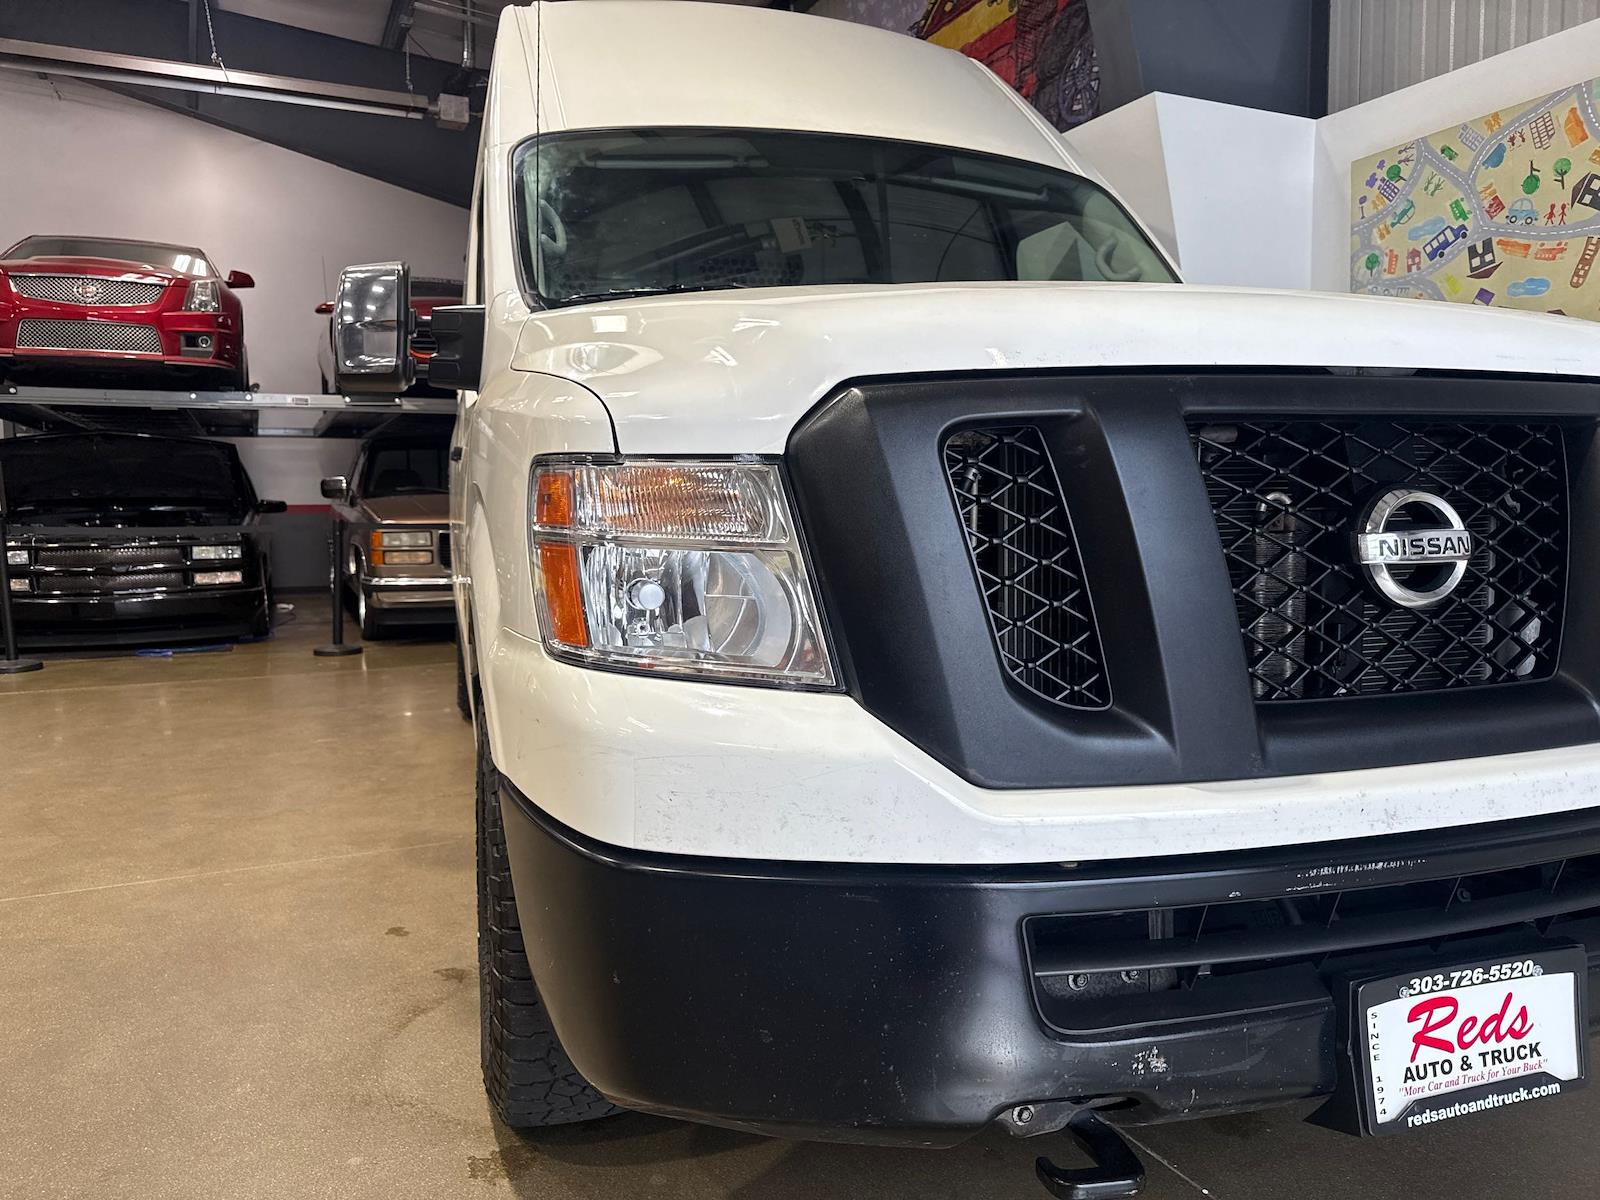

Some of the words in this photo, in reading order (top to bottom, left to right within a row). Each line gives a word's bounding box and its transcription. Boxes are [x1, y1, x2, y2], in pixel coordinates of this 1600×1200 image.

[1379, 535, 1470, 557] NISSAN
[1408, 959, 1534, 995] 303-726-5520
[1407, 991, 1534, 1063] Reds
[1370, 1011, 1381, 1062] SINCE
[1376, 1075, 1387, 1116] 1974
[1403, 1058, 1454, 1084] AUTO
[1460, 1055, 1473, 1072] &
[1478, 1041, 1542, 1068] TRUCK
[1428, 1080, 1443, 1092] Car
[1445, 1075, 1460, 1088] and
[1461, 1070, 1486, 1085] Truck
[1486, 1068, 1500, 1083] for
[1501, 1064, 1521, 1077] Your
[1407, 1082, 1561, 1128] redsautoandtruck.com
